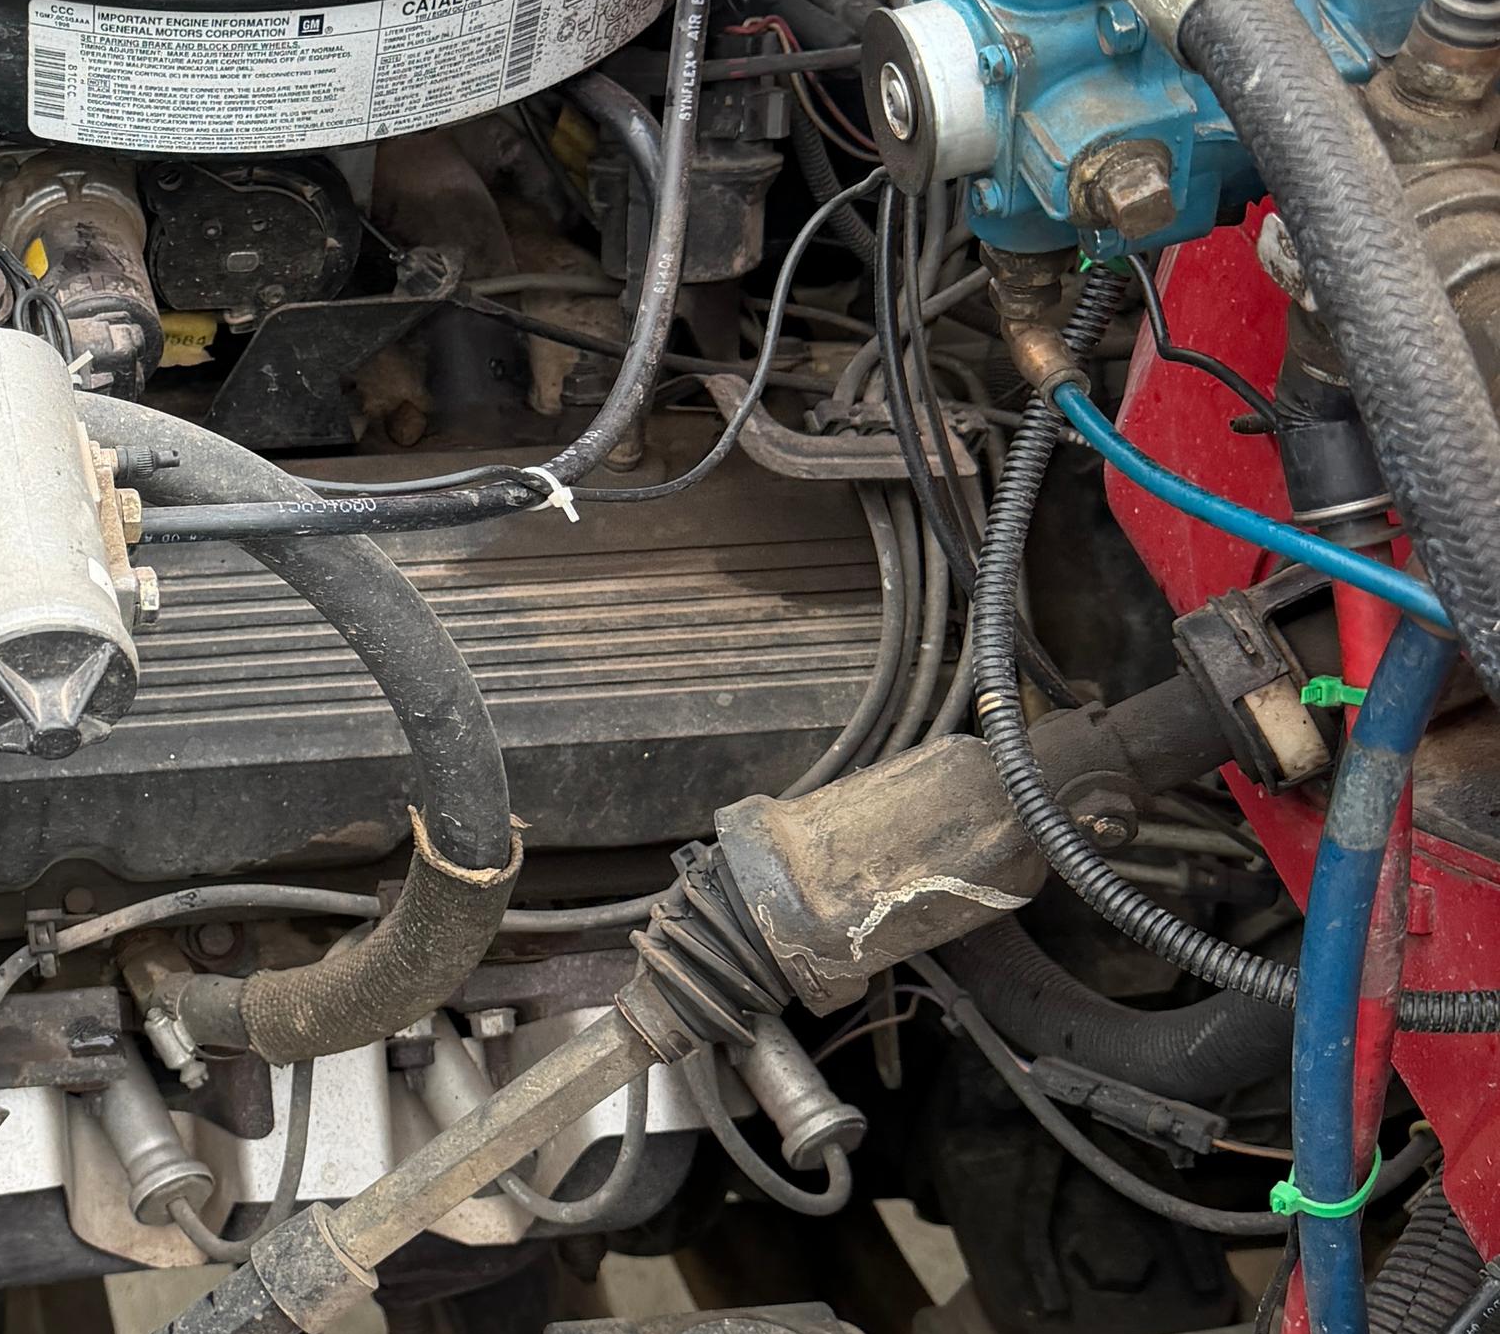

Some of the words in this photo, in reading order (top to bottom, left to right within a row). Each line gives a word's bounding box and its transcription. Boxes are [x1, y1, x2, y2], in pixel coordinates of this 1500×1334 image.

[50, 5, 74, 16] CCC
[97, 11, 162, 25] IMPORTANT
[166, 17, 209, 27] ENGINE
[210, 17, 289, 27] INFORMATION
[302, 18, 321, 32] GM
[100, 21, 152, 35] GENERAL
[155, 26, 202, 38] MOTORS
[205, 27, 285, 38] CORPORATION
[687, 14, 702, 42] AIR
[80, 33, 97, 43] SET
[100, 36, 139, 47] PARKING
[141, 40, 173, 49] BRAKE
[176, 42, 194, 50] AND
[197, 43, 228, 51] BLOCK
[230, 42, 258, 51] DRIVE
[80, 42, 106, 51] TIMING
[268, 49, 297, 57] ENGINE
[311, 44, 345, 54] NORMAL
[80, 49, 124, 60] OPERATING
[126, 54, 184, 64] TEMPERATURE
[220, 57, 277, 65] CONDITIONING
